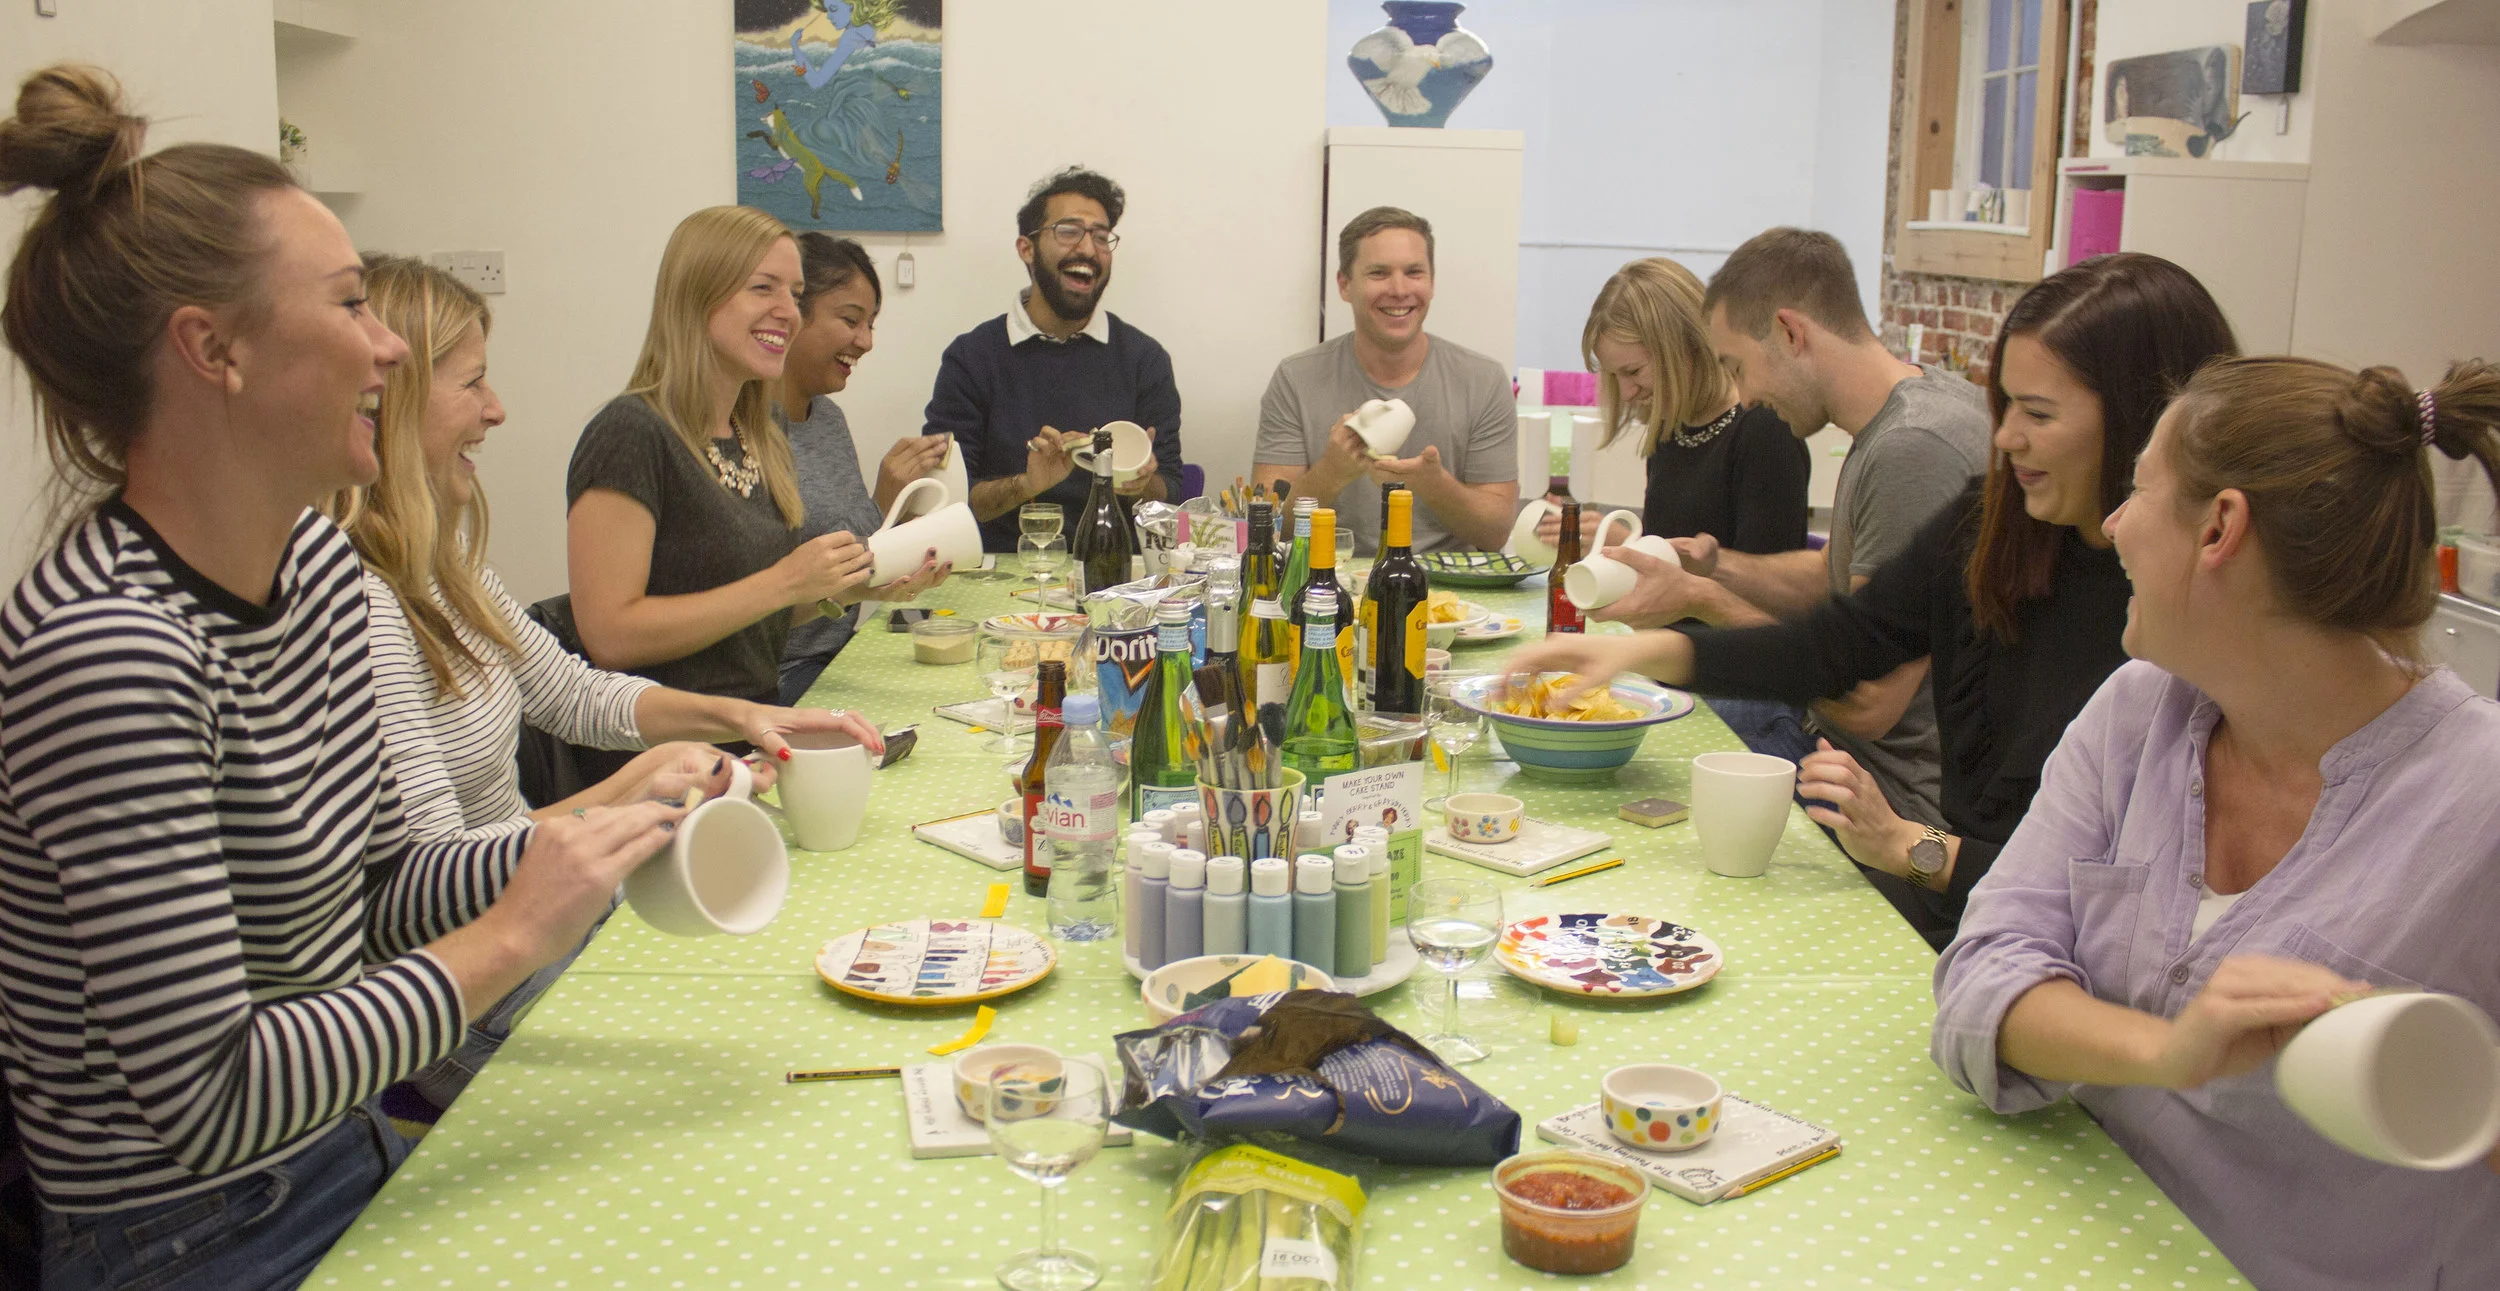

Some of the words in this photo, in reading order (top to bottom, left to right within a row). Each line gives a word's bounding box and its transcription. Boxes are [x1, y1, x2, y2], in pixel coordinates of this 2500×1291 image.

[1342, 777, 1362, 789] MAKE
[1364, 774, 1383, 785] YOUR
[1385, 771, 1405, 781] OWN
[1349, 785, 1369, 796] CAKE
[1371, 781, 1395, 793] STAND
[1046, 806, 1085, 828] vian
[1654, 1165, 1673, 1178] The
